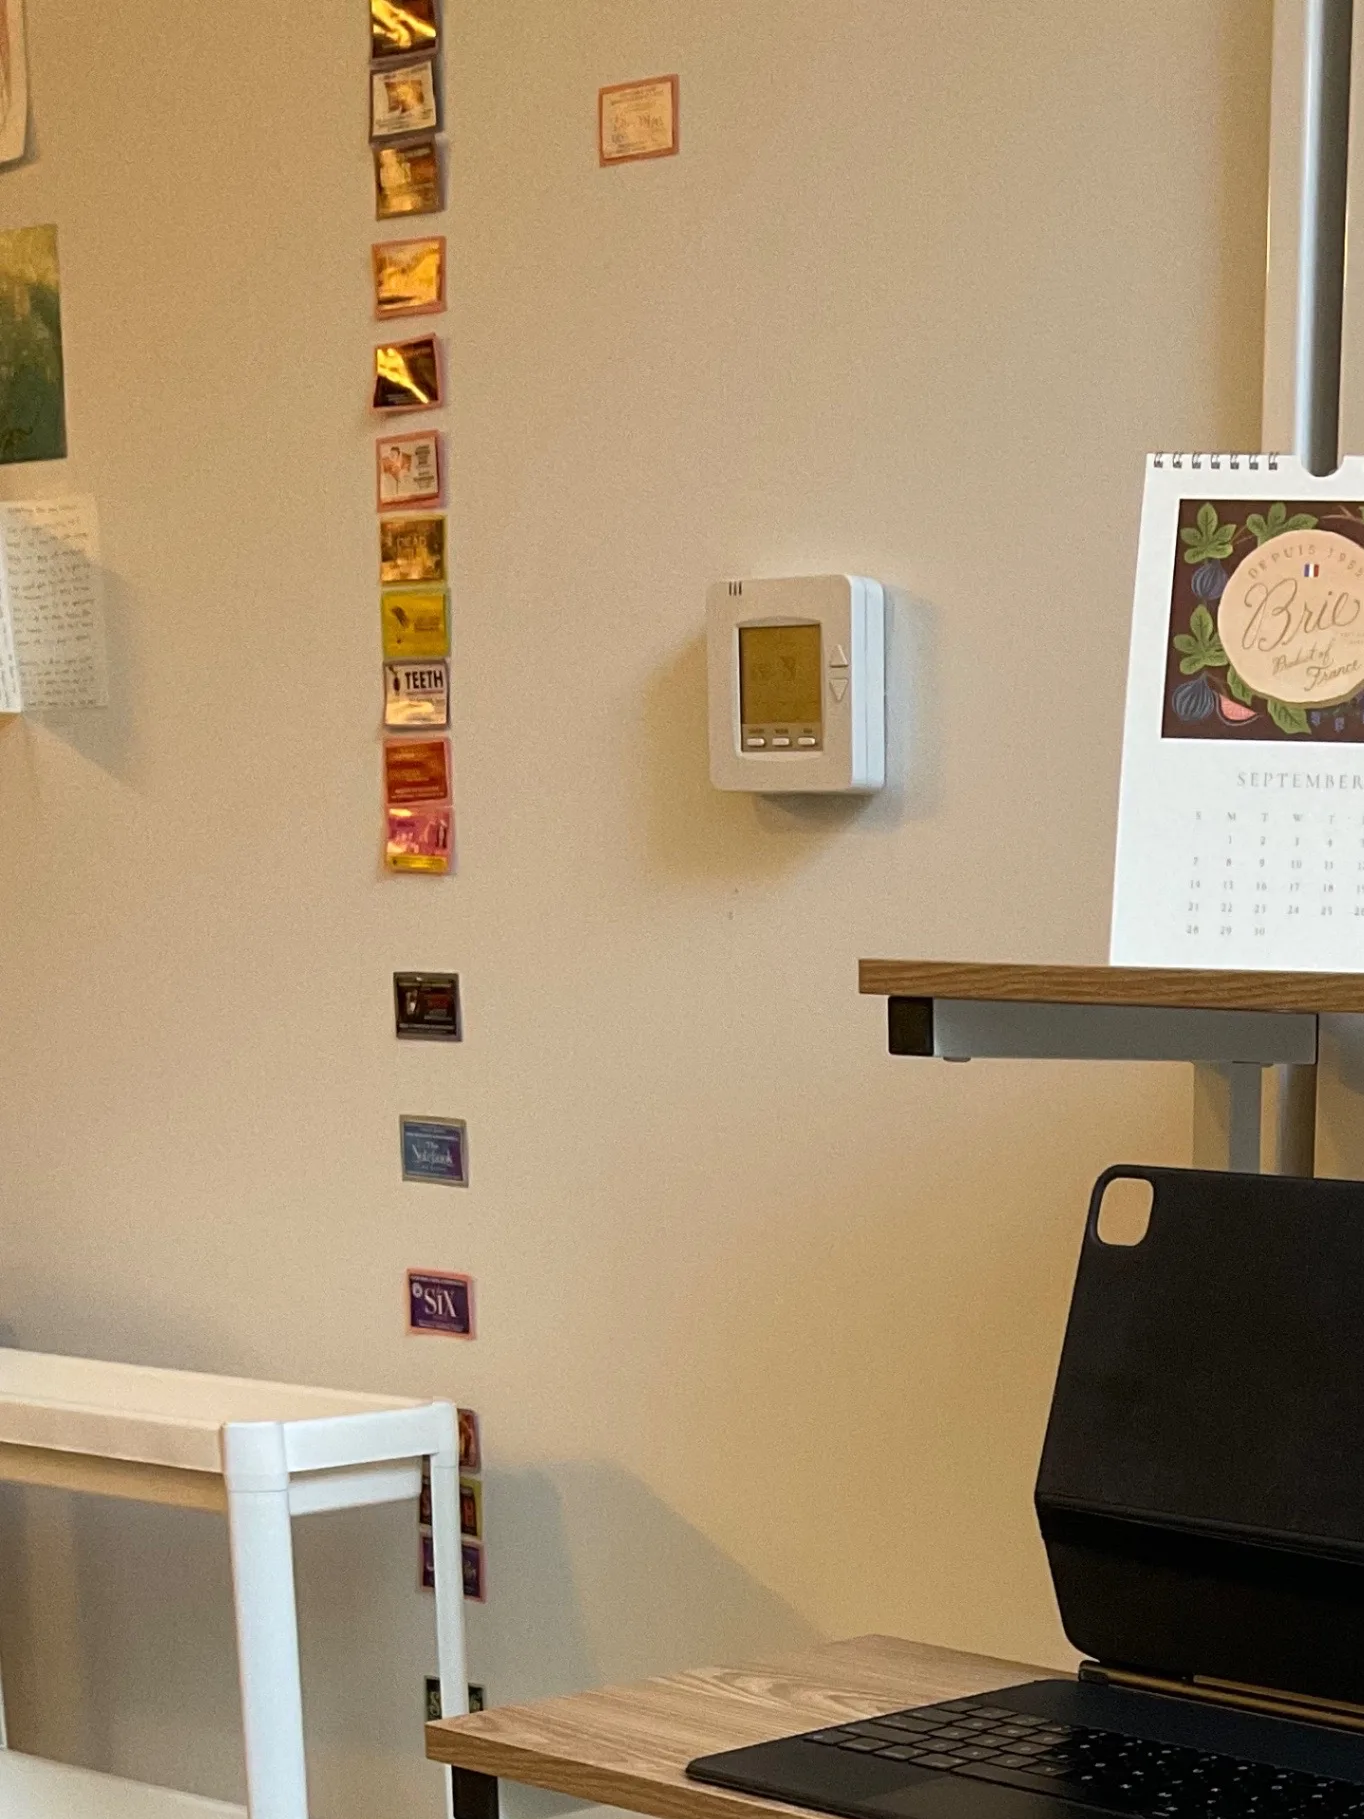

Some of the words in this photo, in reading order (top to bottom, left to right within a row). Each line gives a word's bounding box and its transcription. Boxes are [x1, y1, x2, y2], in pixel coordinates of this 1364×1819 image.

[1248, 544, 1316, 579] DEPUIS
[1242, 578, 1360, 652] Brie
[405, 670, 443, 689] TEETH
[1304, 658, 1362, 691] France
[1237, 772, 1364, 789] SEPTEMBER
[424, 1287, 457, 1318] SIX
